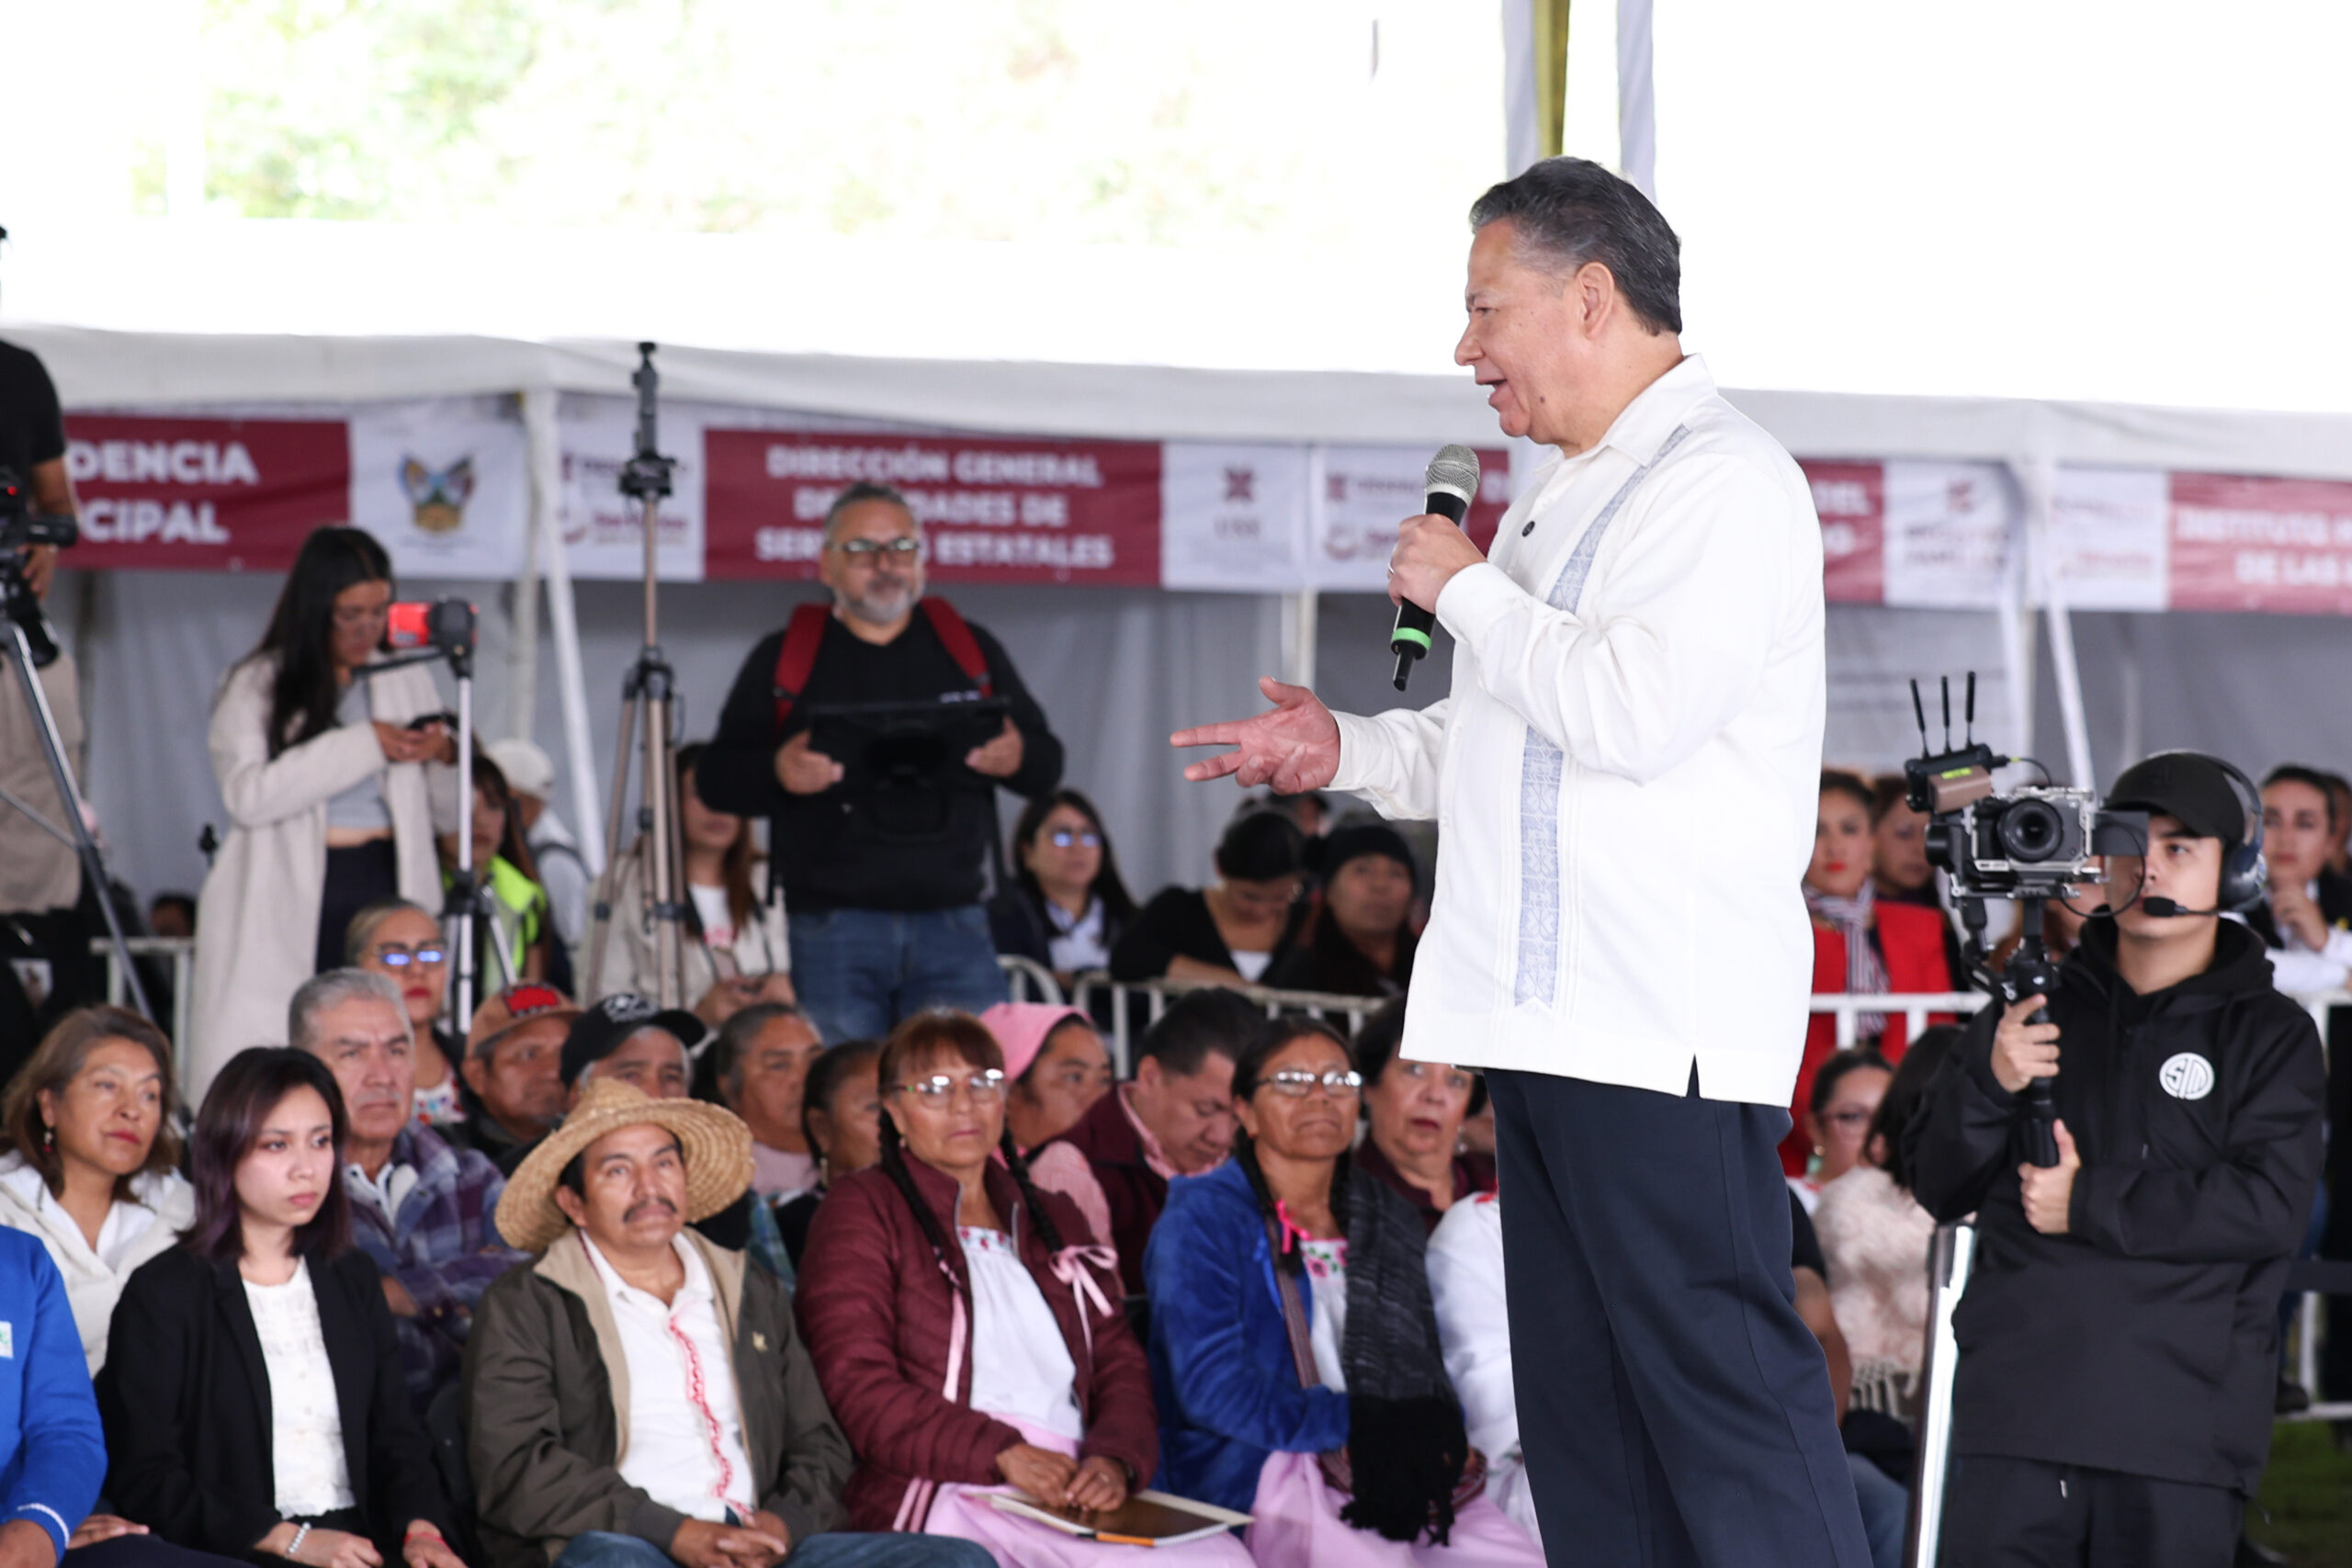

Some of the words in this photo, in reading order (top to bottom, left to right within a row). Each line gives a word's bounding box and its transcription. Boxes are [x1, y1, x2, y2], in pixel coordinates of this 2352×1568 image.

[64, 439, 259, 485] DENCIA
[954, 448, 1105, 488] GENERAL
[79, 500, 230, 544] CIPAL
[1022, 493, 1068, 527] DE
